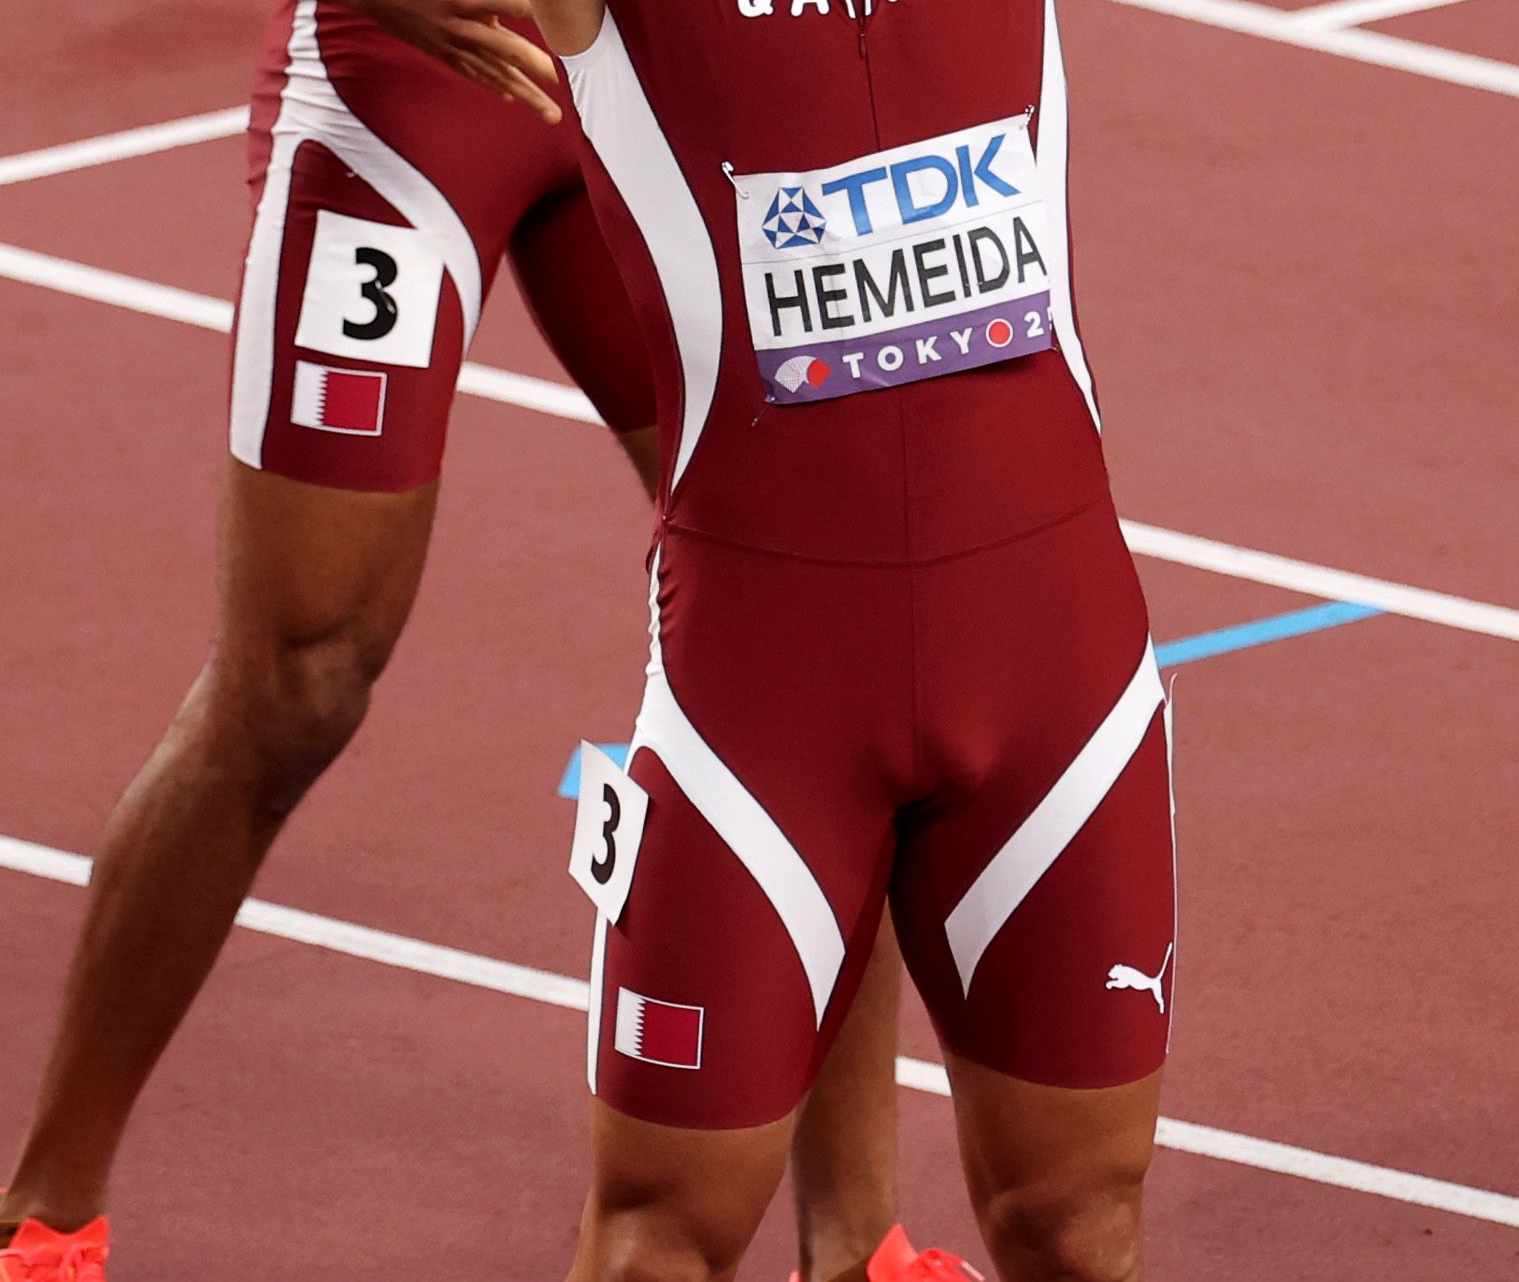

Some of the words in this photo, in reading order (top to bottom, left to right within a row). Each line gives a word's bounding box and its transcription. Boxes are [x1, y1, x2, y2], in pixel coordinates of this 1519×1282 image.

[821, 133, 1022, 237] TDK
[342, 246, 398, 341] 3
[764, 215, 1048, 337] HEMEIDA
[1024, 307, 1052, 338] 2
[591, 783, 621, 885] 3
